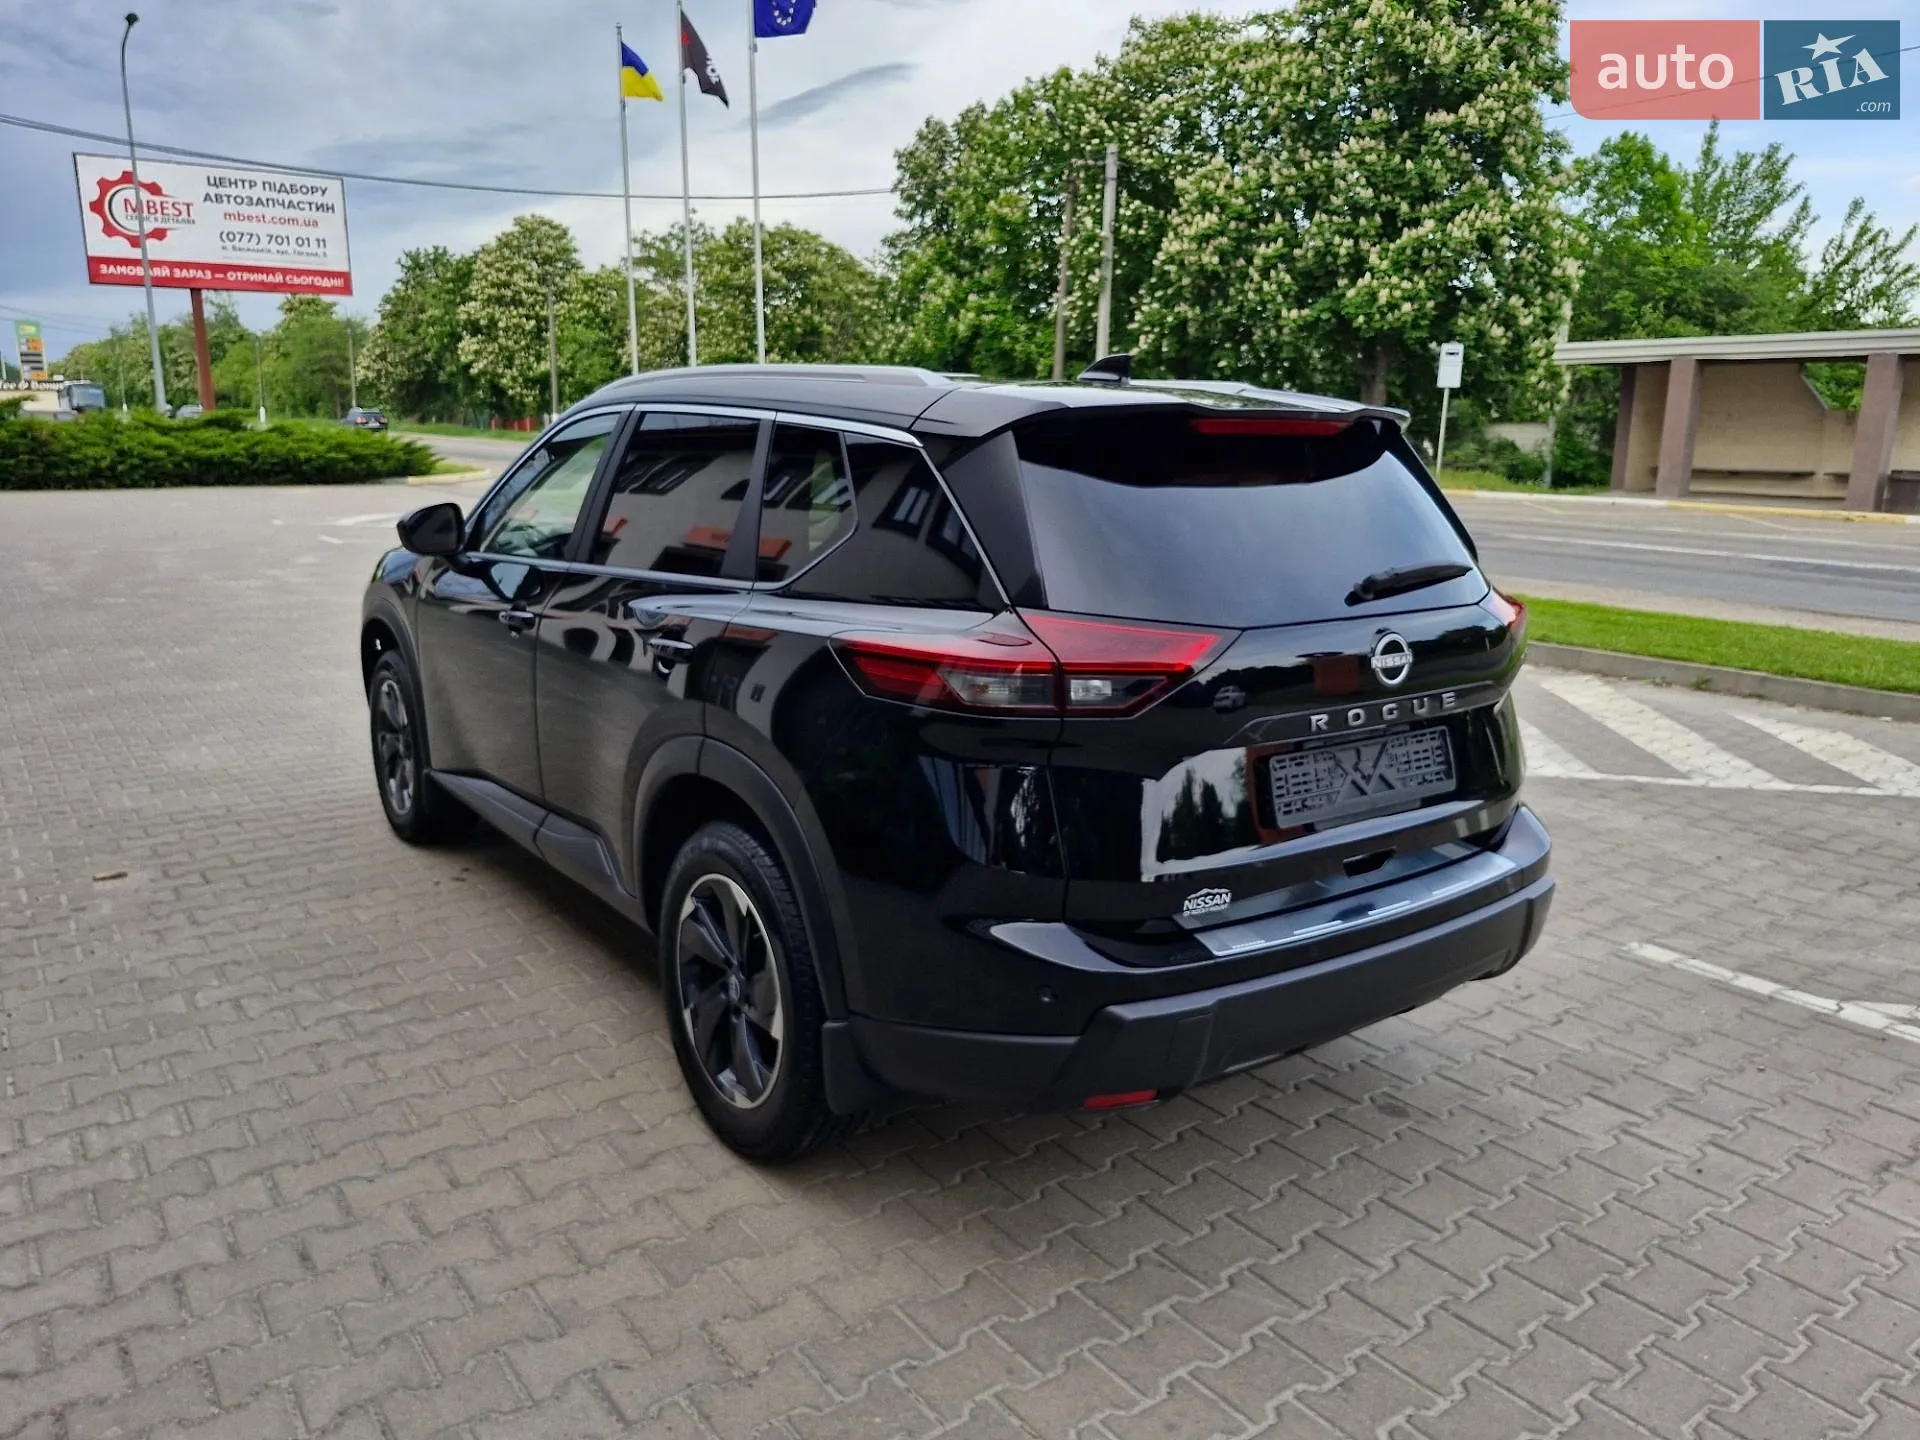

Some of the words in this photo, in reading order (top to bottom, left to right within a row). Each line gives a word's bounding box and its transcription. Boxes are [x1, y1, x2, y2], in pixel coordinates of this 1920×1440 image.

[206, 175, 258, 189] ЦЕНТР
[262, 180, 328, 197] ПІДБОРУ
[123, 198, 194, 218] MBEST
[203, 192, 336, 214] АВТОЗАПЧАСТИН
[223, 210, 319, 228] mbest.com.ua
[219, 230, 261, 246] (077)
[266, 233, 291, 247] 701
[295, 235, 311, 248] 01
[314, 237, 327, 249] 11
[173, 267, 212, 280] ЗАРАЗ
[226, 271, 283, 284] ОТРИМАЙ
[1371, 650, 1412, 669] NISSAN
[1309, 691, 1457, 732] ROGUE
[1183, 892, 1232, 911] NISSAN
